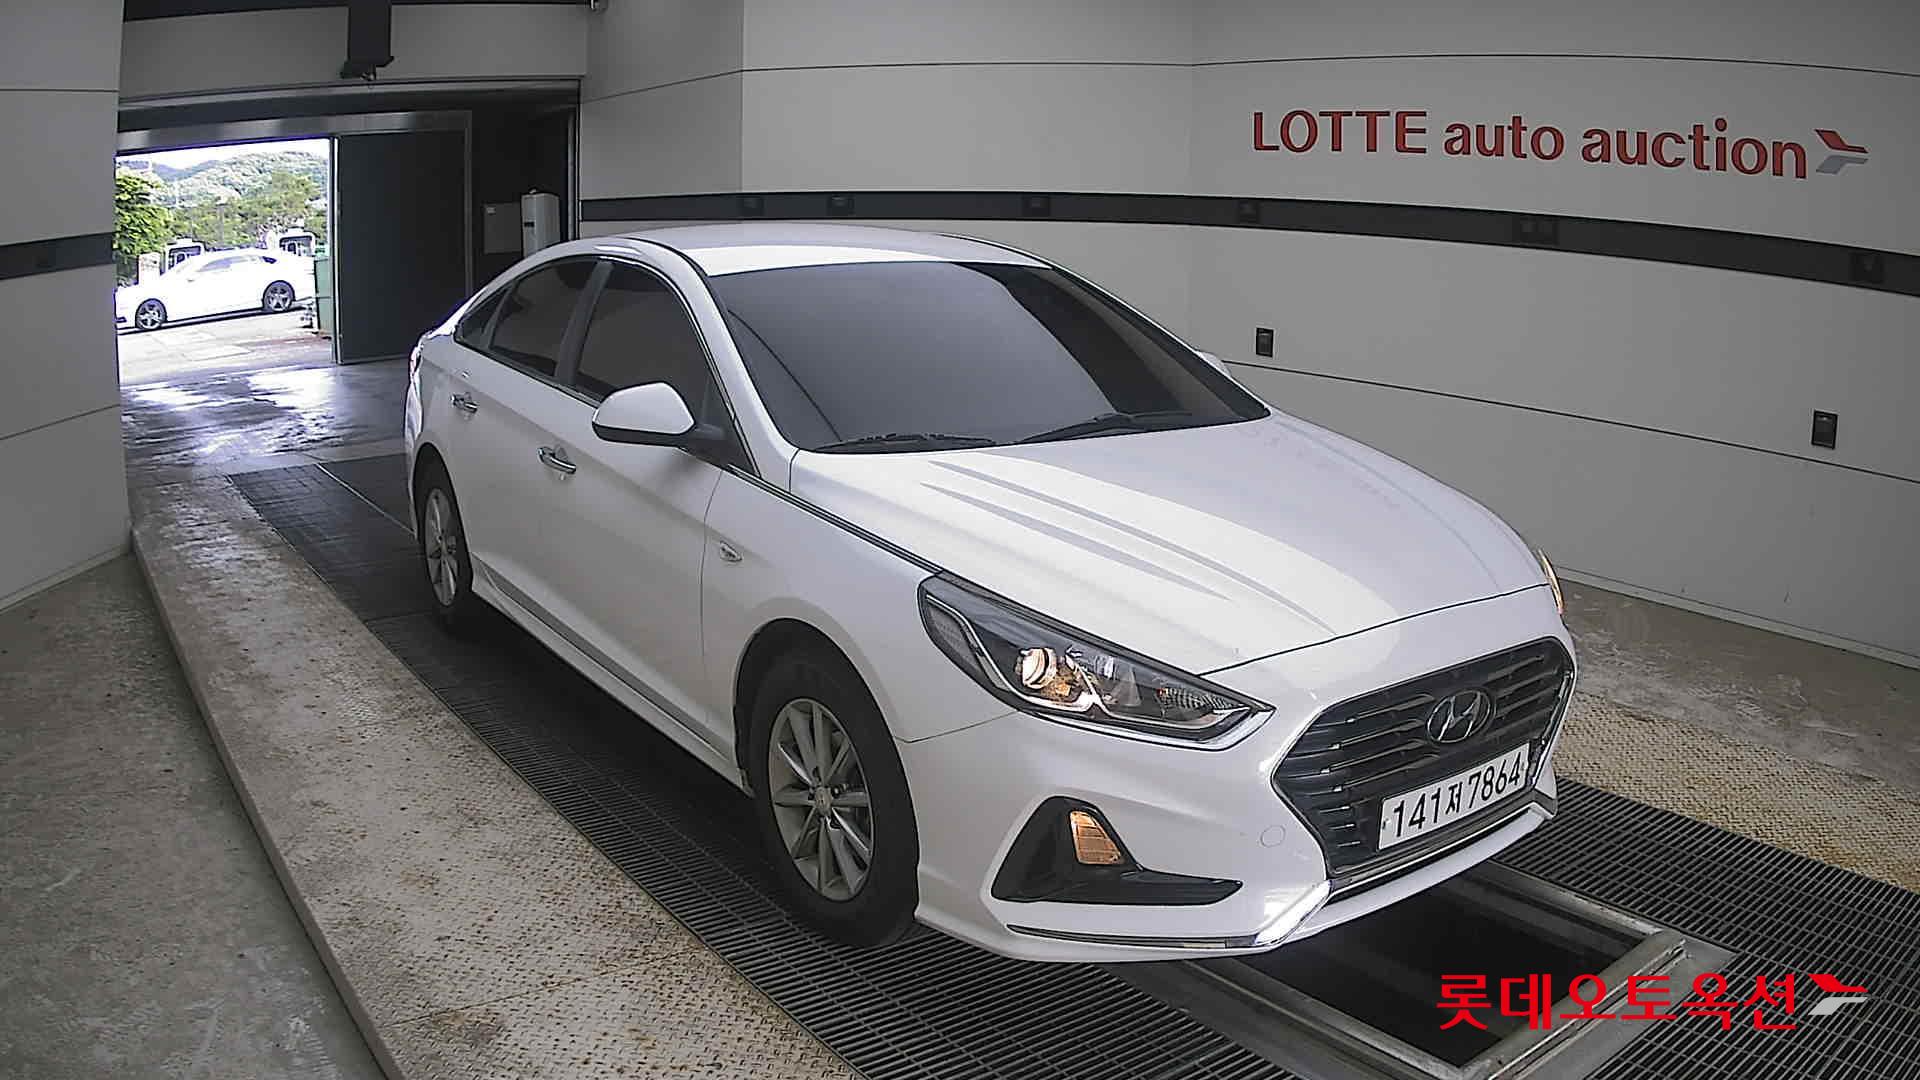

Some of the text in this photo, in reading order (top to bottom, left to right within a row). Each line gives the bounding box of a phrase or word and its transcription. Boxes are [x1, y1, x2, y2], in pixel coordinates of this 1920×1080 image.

[1253, 110, 1807, 179] LOTTE auto auction
